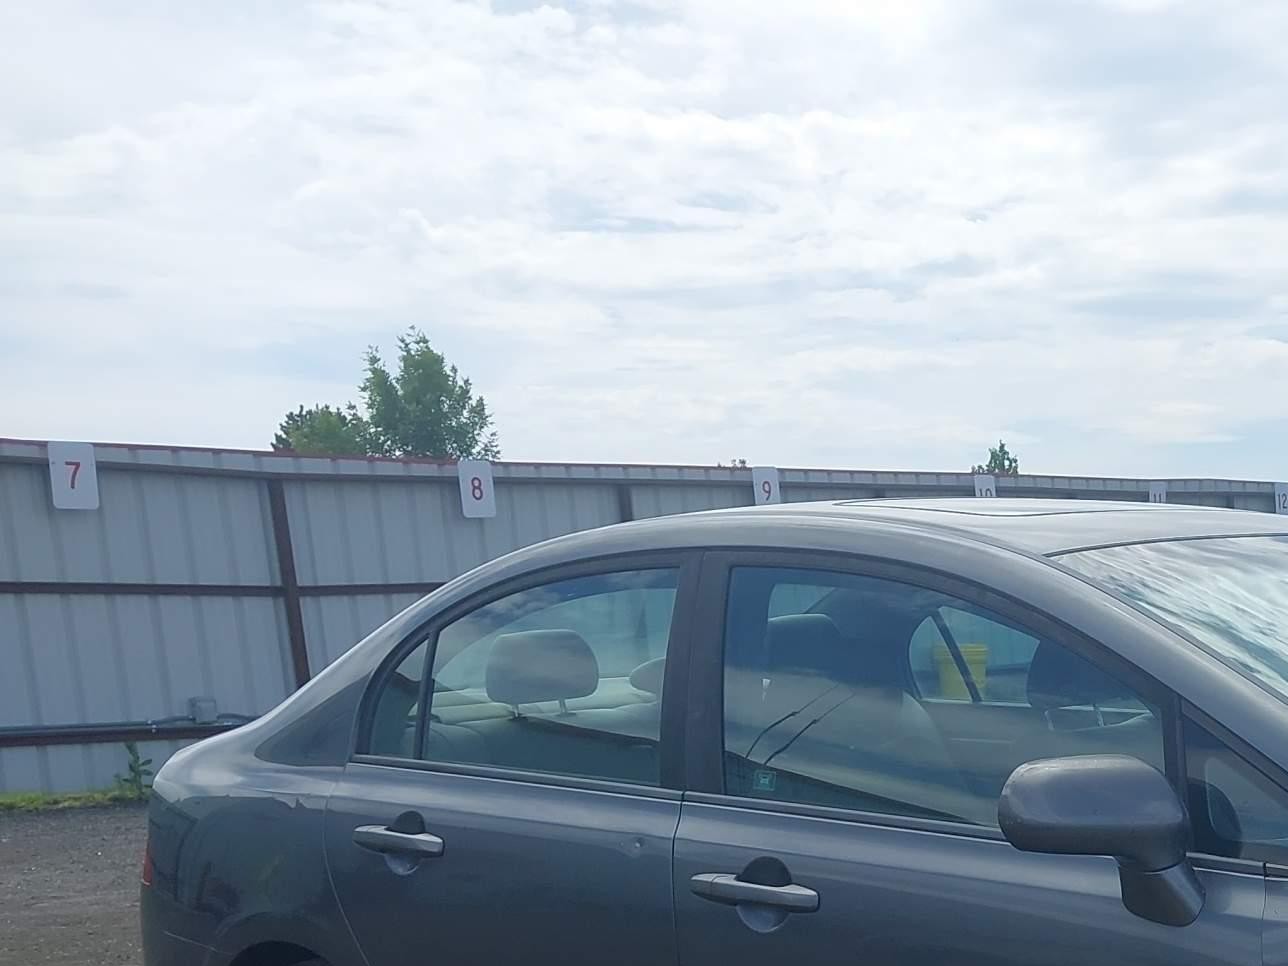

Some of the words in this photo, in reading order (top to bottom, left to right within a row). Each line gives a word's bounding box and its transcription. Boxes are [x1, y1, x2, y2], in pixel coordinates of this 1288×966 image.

[64, 461, 81, 490] 7
[471, 477, 484, 501] 8
[762, 480, 772, 501] 9
[1277, 492, 1288, 510] 12
